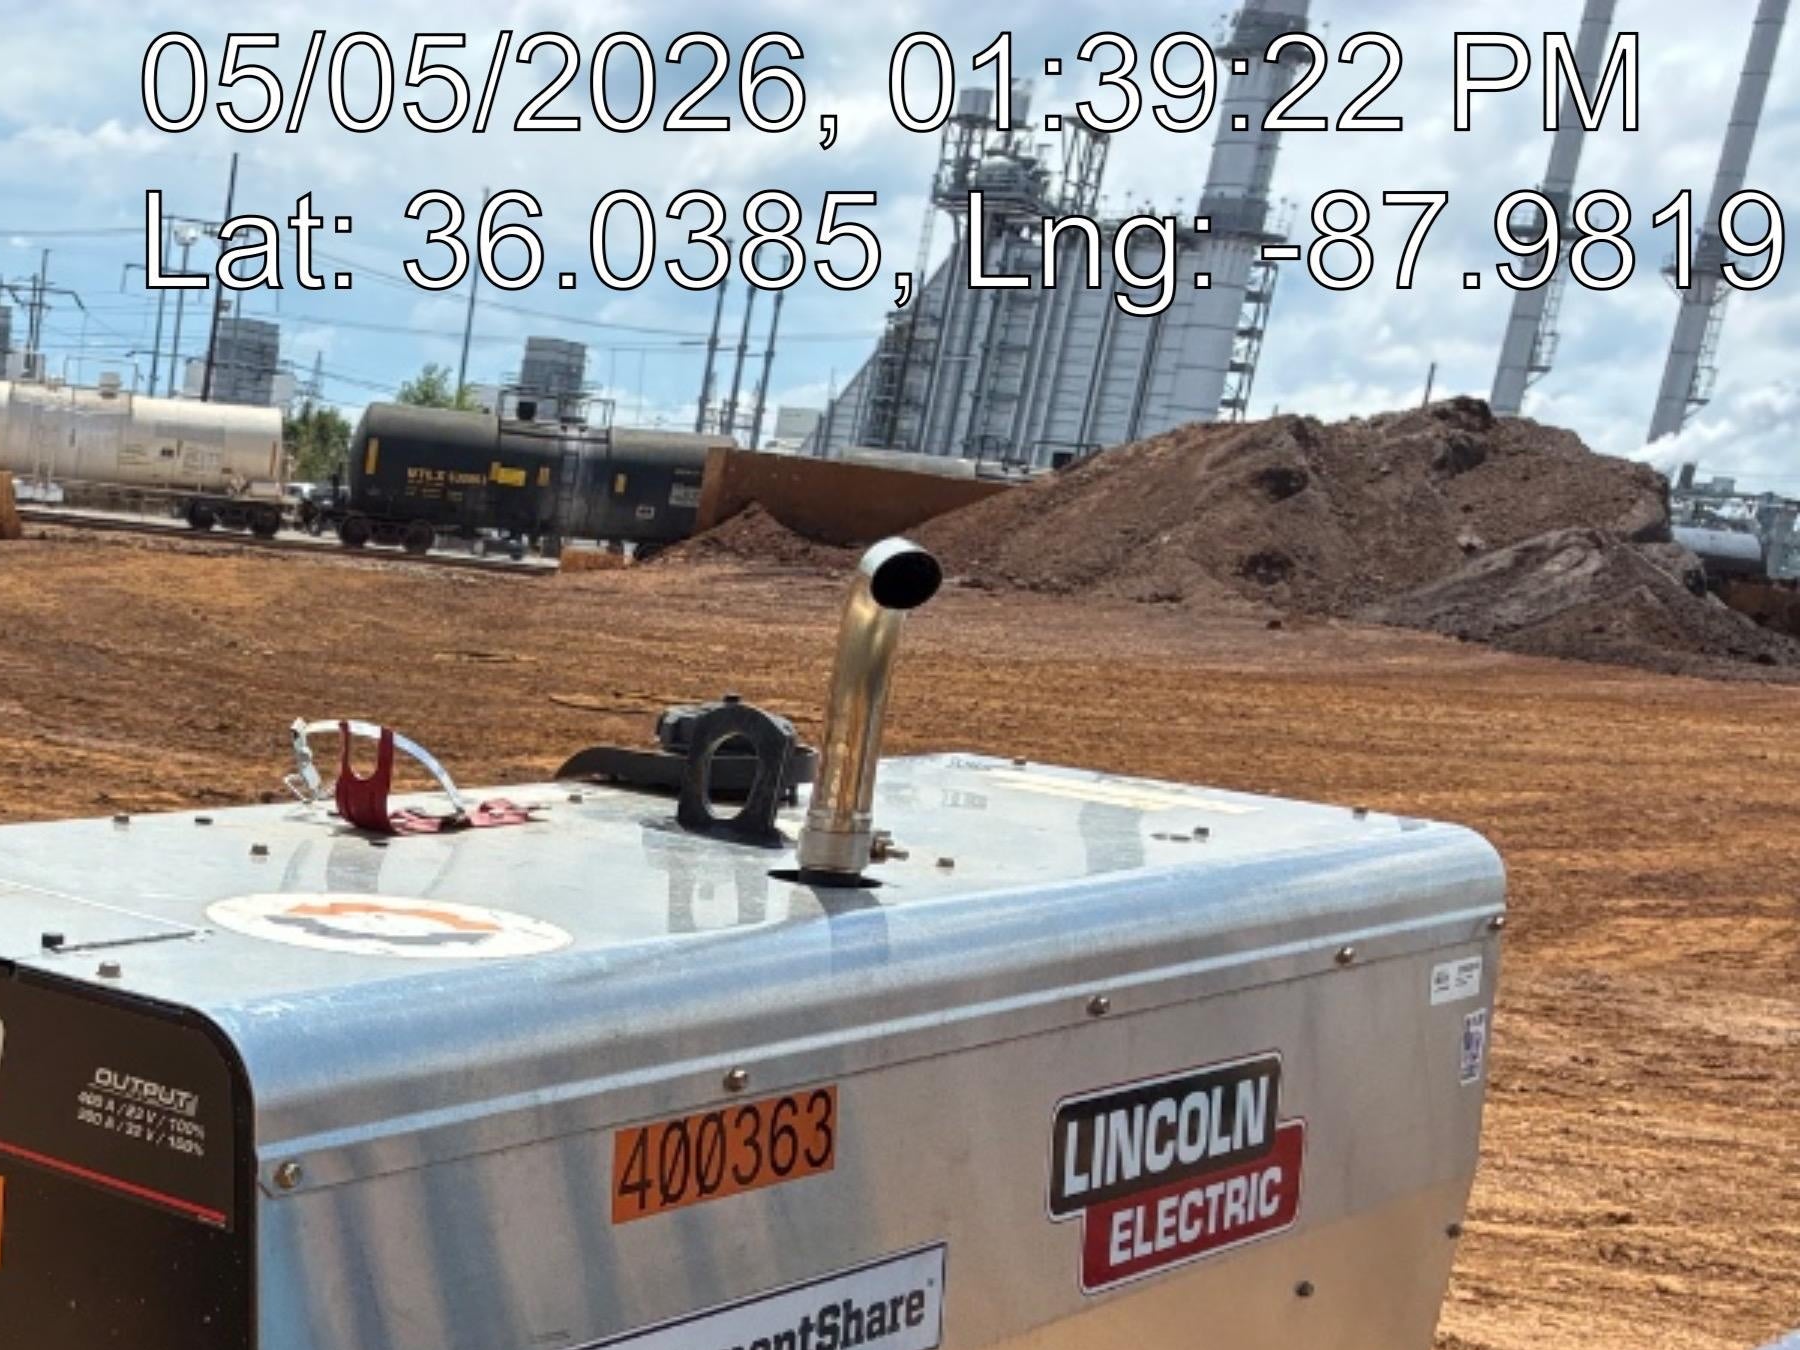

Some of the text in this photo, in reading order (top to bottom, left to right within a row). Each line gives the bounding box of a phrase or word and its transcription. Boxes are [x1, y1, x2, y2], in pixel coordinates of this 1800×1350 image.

[94, 1067, 193, 1110] OUTPUT
[1063, 1076, 1270, 1198] LINCOLN
[618, 1088, 835, 1210] 400363
[1109, 1165, 1283, 1267] ELECTRIC
